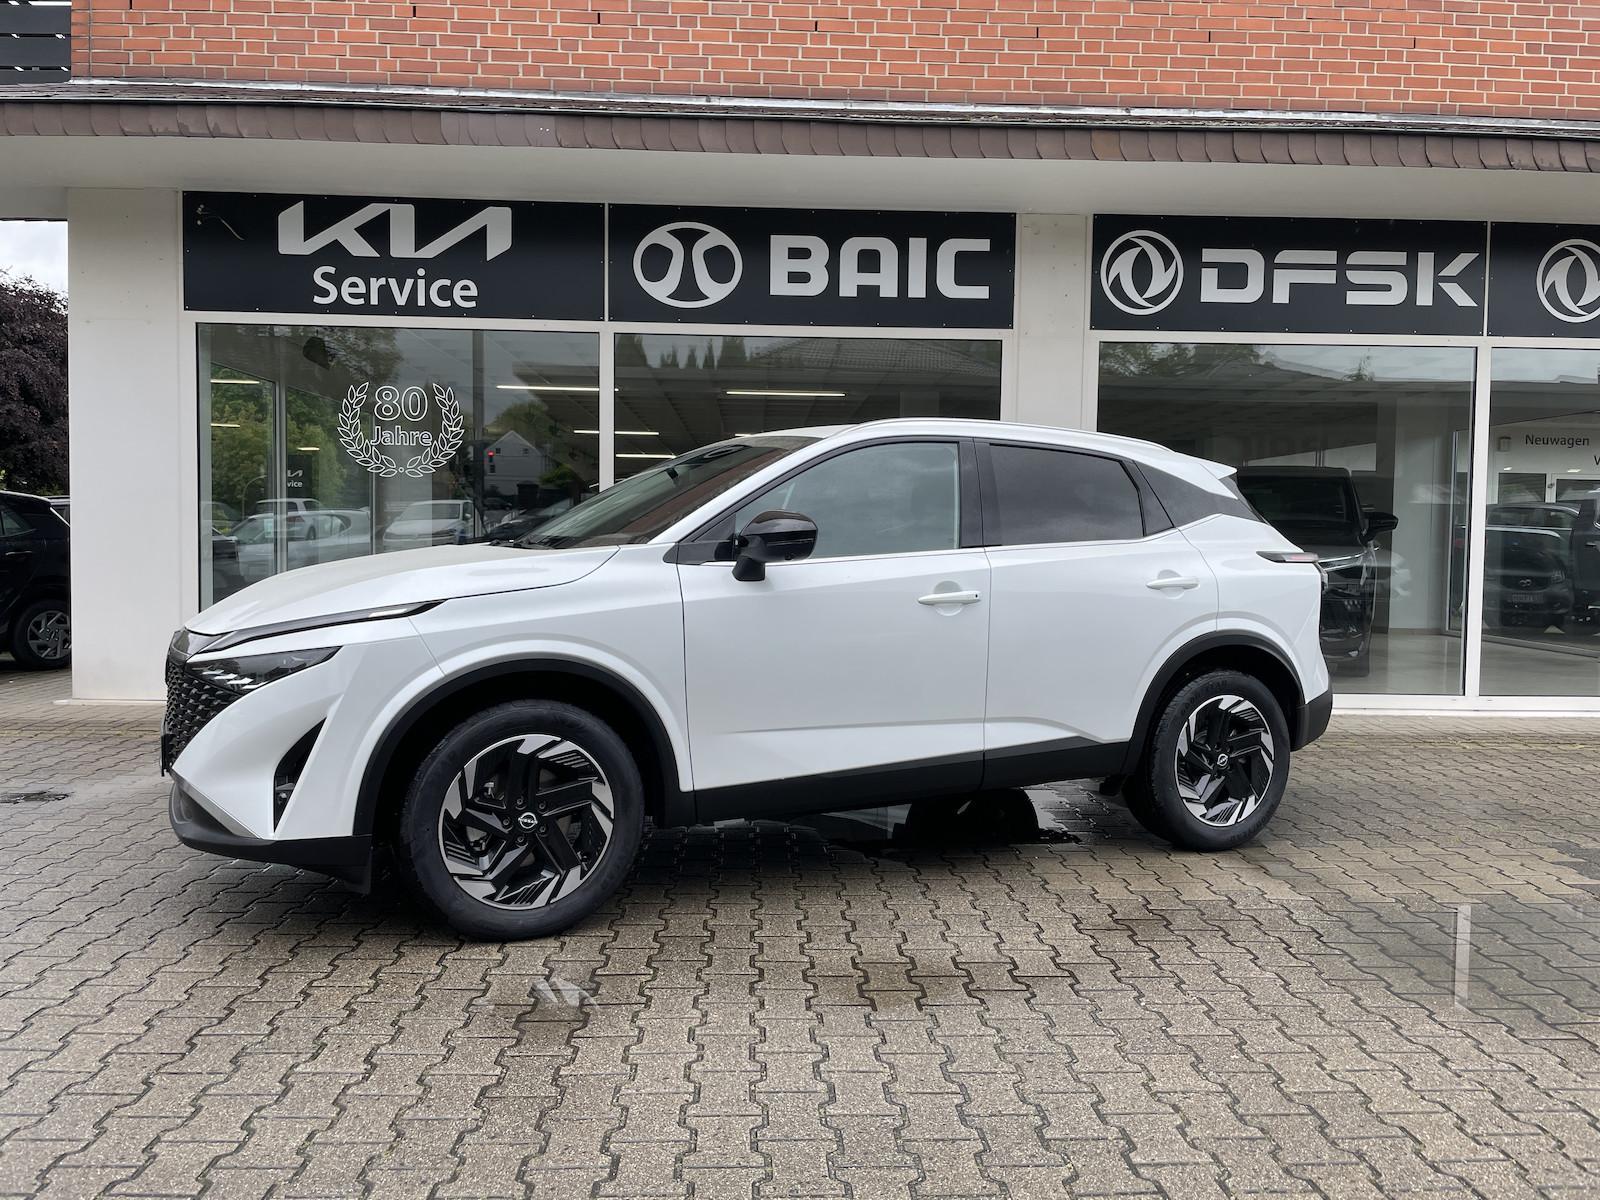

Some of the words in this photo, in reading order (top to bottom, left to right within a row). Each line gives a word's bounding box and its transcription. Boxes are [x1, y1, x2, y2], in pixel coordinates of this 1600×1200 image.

[278, 200, 513, 262] KIA
[312, 265, 478, 309] Service
[769, 234, 991, 300] BAIC
[1200, 248, 1480, 307] DFSK
[374, 385, 428, 422] 80
[370, 425, 433, 446] Jahre
[1525, 434, 1590, 449] Neuwagen
[287, 479, 303, 488] vice
